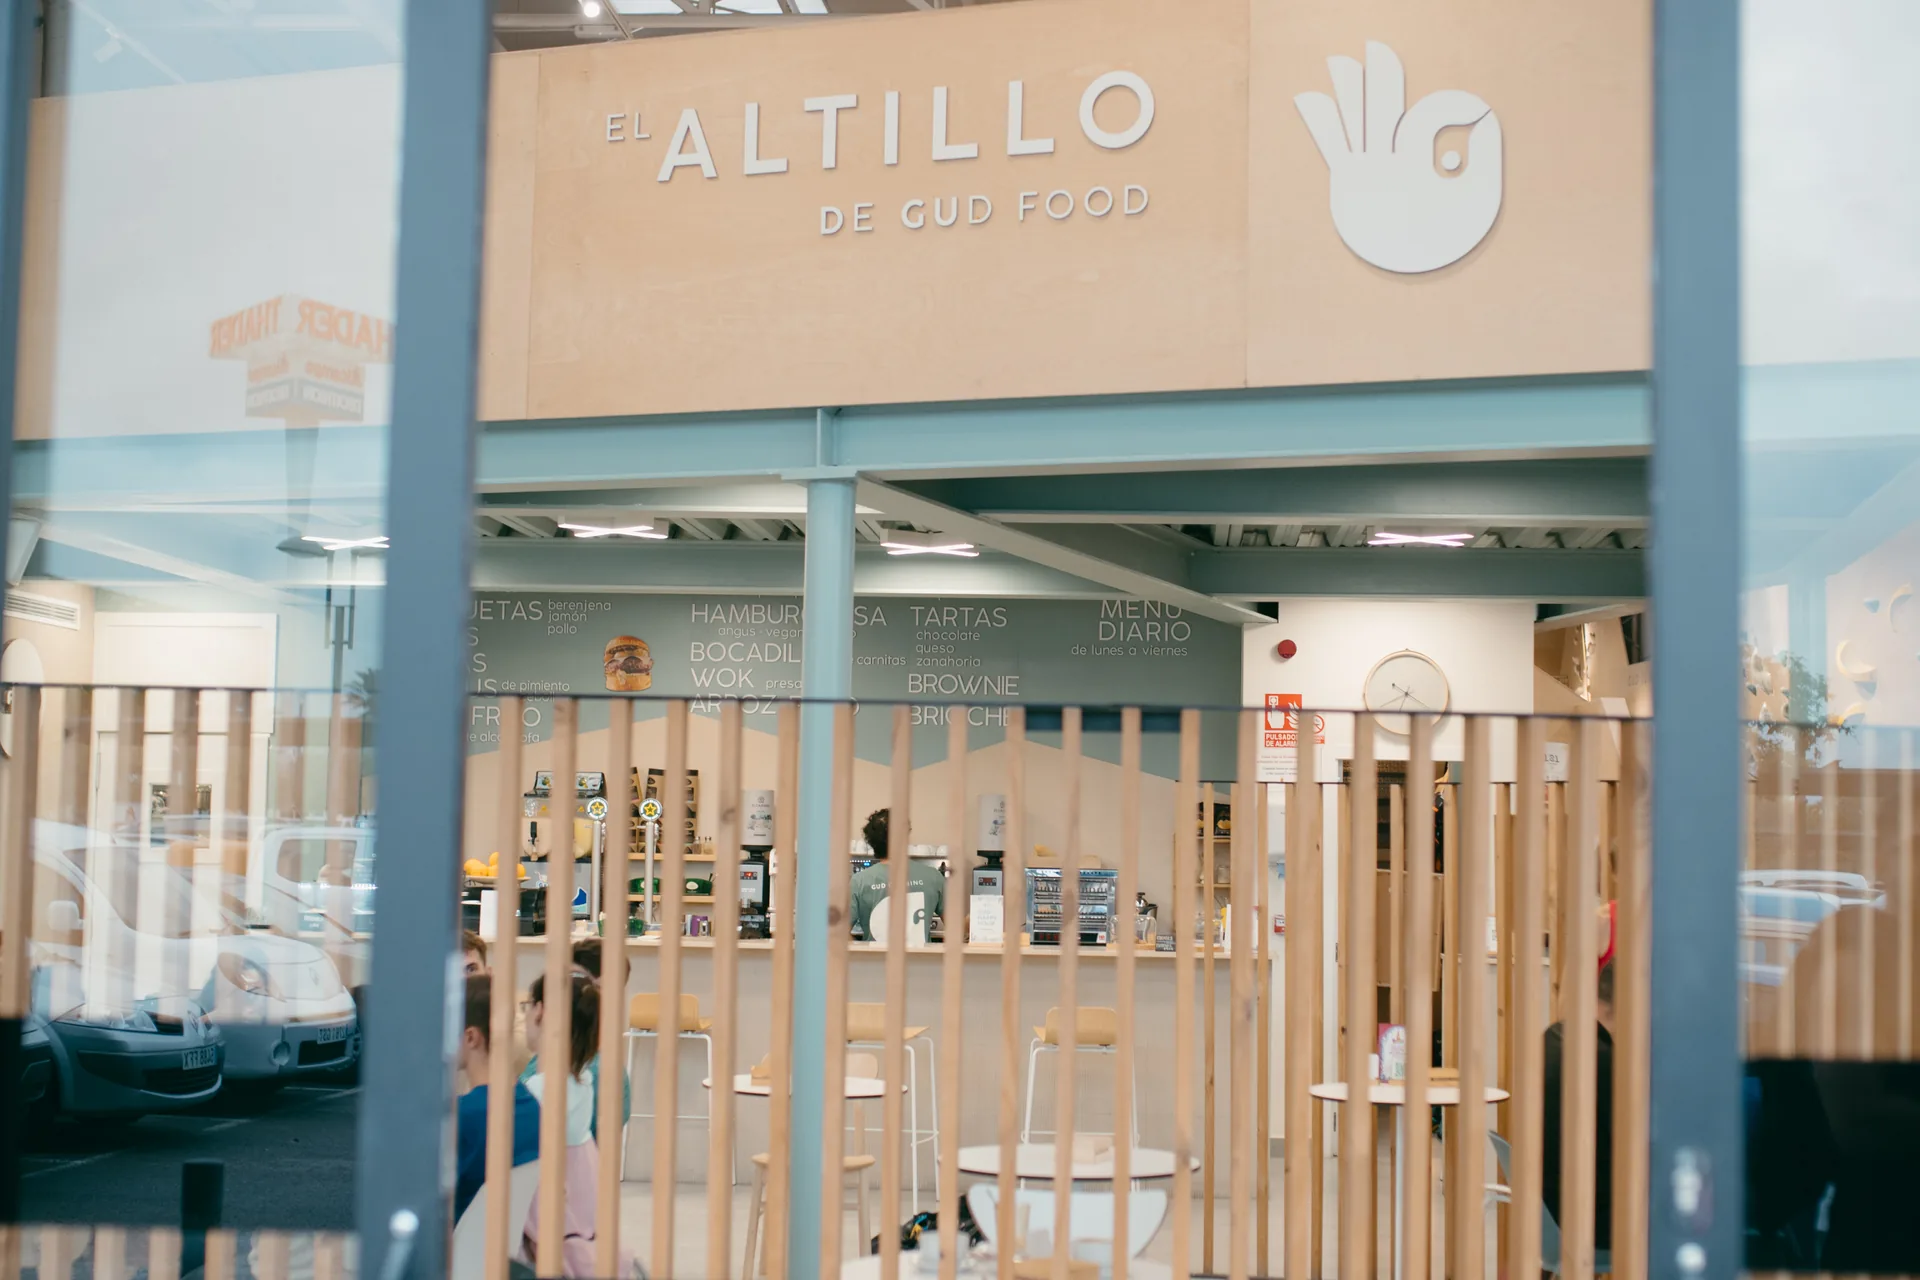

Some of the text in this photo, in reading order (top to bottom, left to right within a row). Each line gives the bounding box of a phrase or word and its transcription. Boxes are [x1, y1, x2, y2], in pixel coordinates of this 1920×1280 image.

[606, 70, 1156, 183] EL ALTILLO
[820, 184, 1149, 235] DE GUD FOOD
[548, 599, 612, 612] berenjena
[548, 611, 587, 623] jamón
[910, 606, 1008, 627] TARTAS
[547, 624, 578, 636] pollo
[718, 627, 756, 639] angus
[916, 630, 981, 641] chocolate
[1099, 621, 1191, 642] DIARIO
[916, 643, 955, 655] queso
[1071, 644, 1188, 657] de lunes a viernes
[856, 654, 907, 666] carnitas
[916, 656, 981, 667] zanahoria
[690, 668, 754, 688] WOK
[908, 673, 1019, 696] BROWNIE
[501, 680, 516, 692] de
[520, 680, 570, 693] pimiento
[871, 882, 886, 890] GUD
